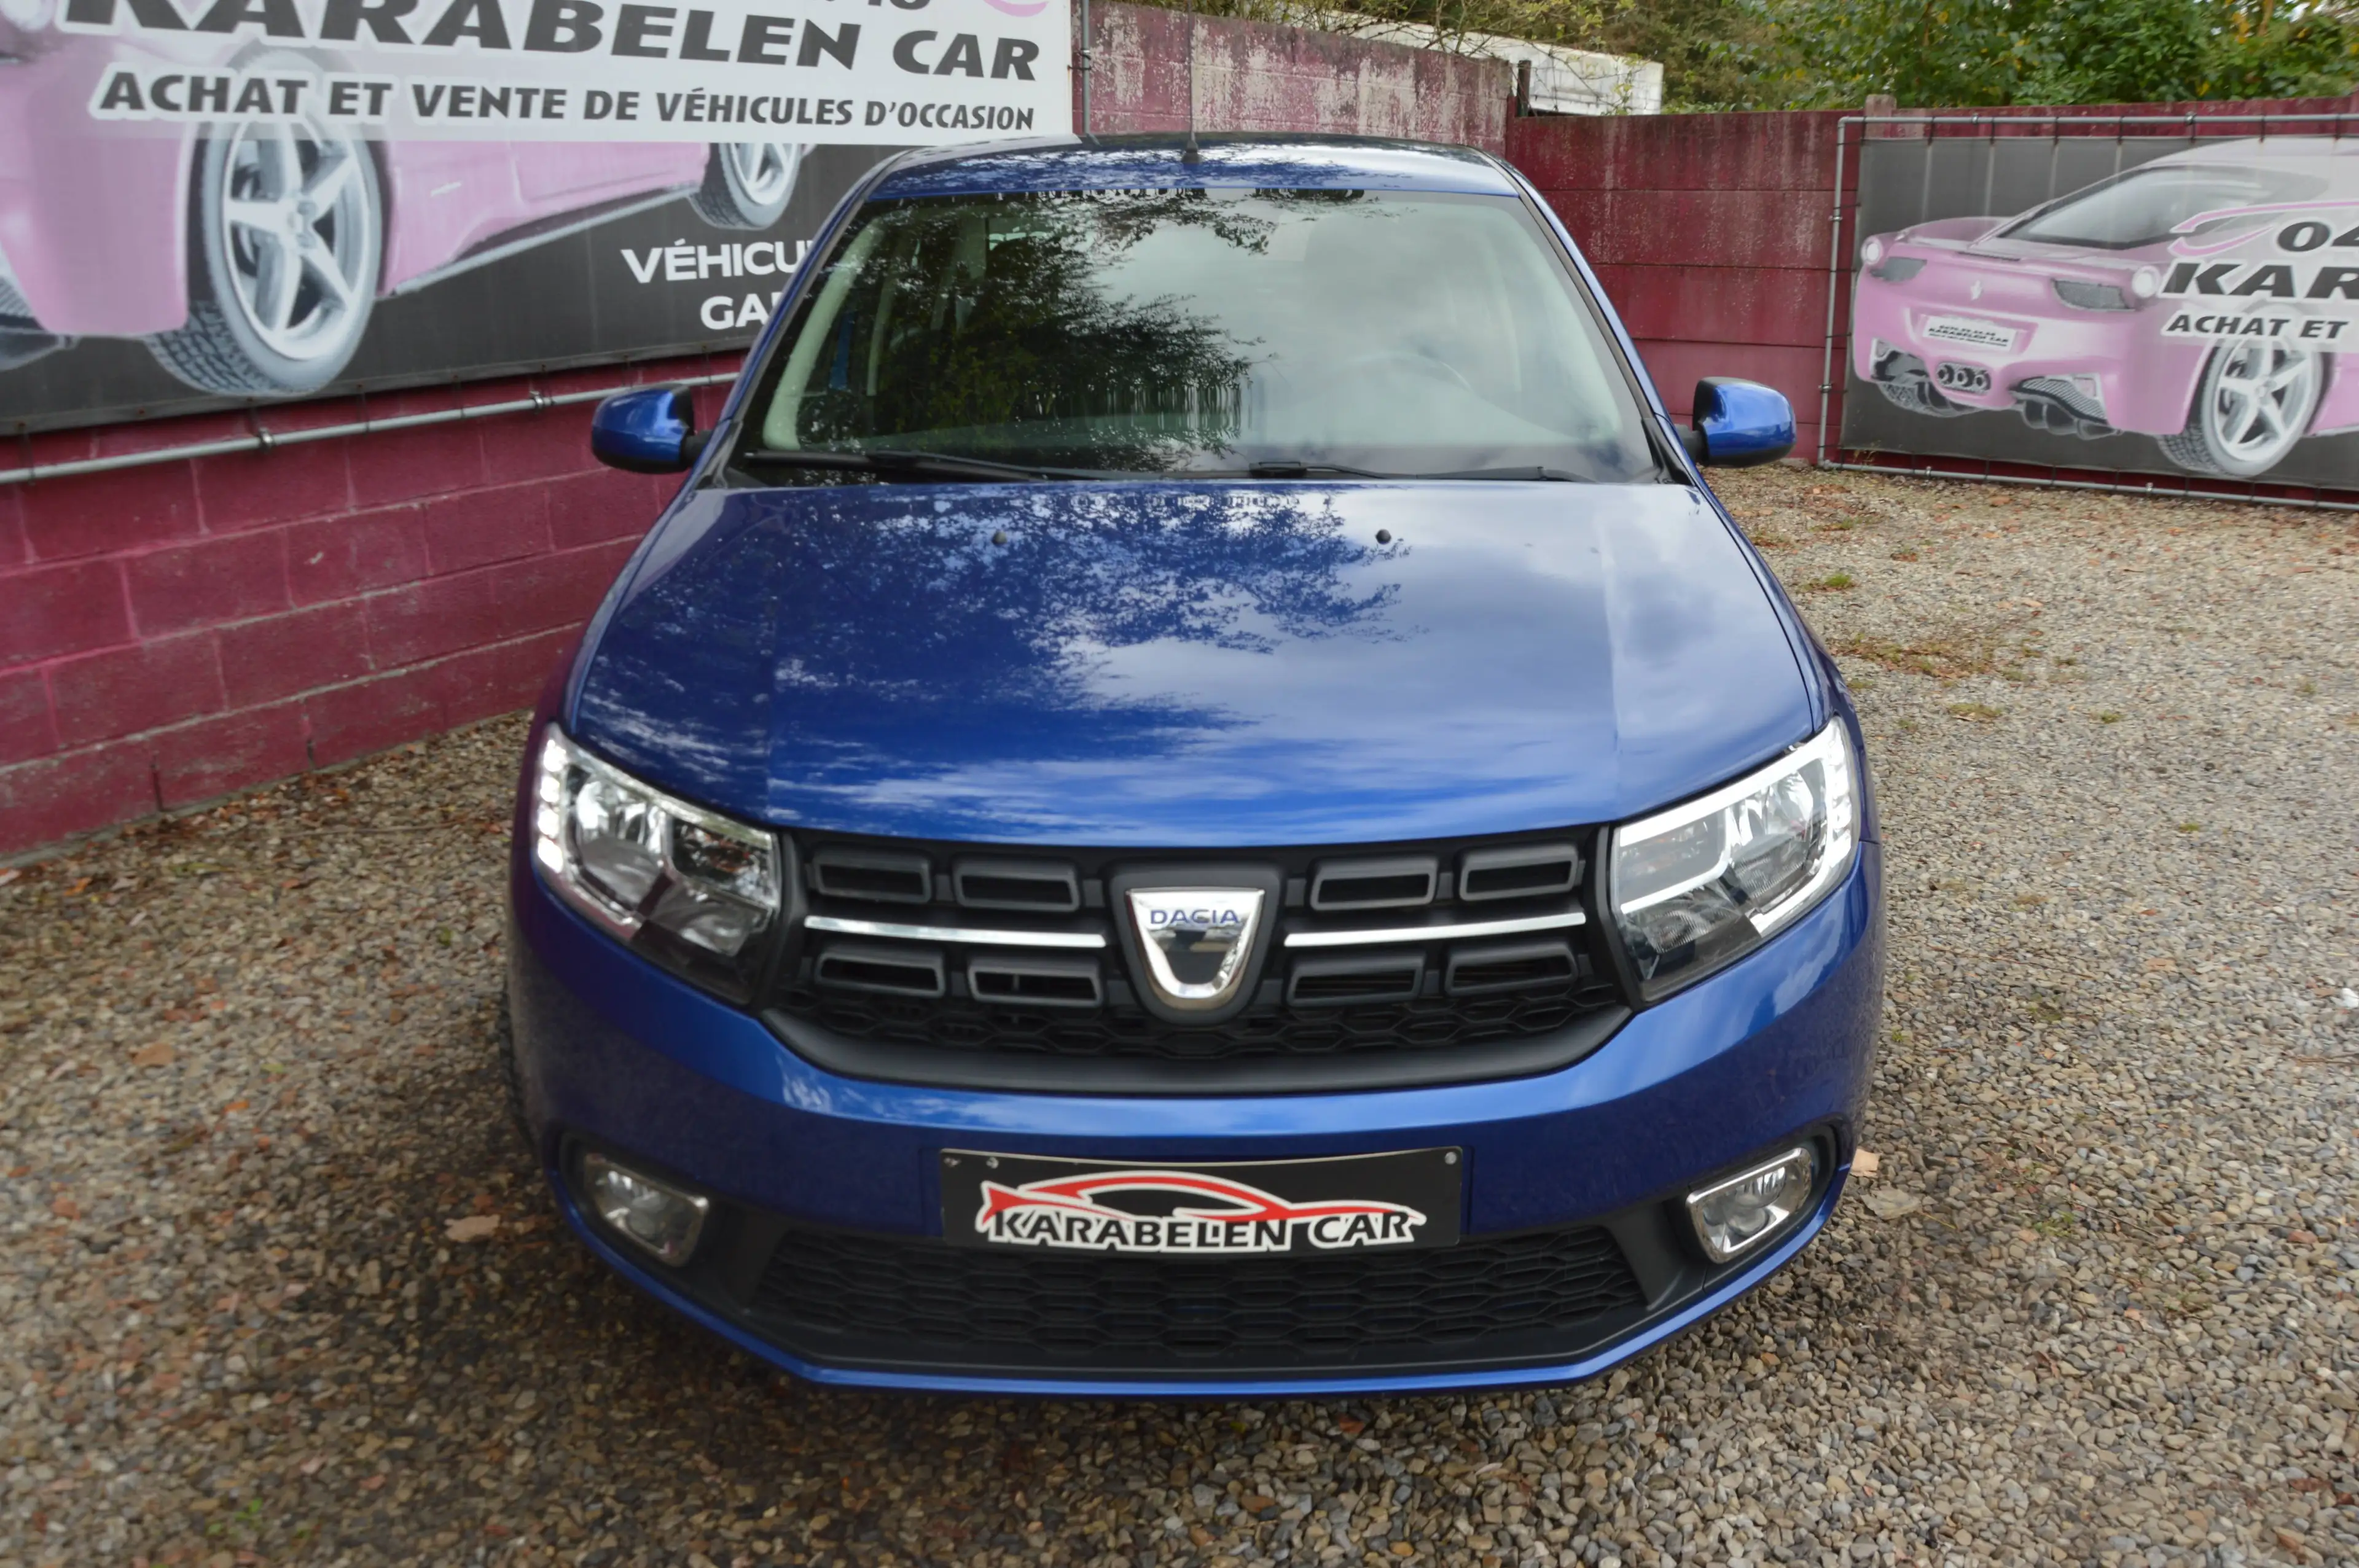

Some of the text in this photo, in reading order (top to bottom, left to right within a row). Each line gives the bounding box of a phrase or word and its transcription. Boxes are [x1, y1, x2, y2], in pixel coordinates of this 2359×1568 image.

[893, 30, 1039, 81] CAR
[99, 71, 1034, 130] ACHAT ET VENTE DE VÉHICULES D'OCCASION
[620, 238, 813, 284] VÉHICU
[700, 292, 784, 330] GA
[2166, 314, 2350, 339] ACHAT ET
[1150, 909, 1240, 924] DACIA
[994, 1211, 1409, 1248] KARABELEN CAR
